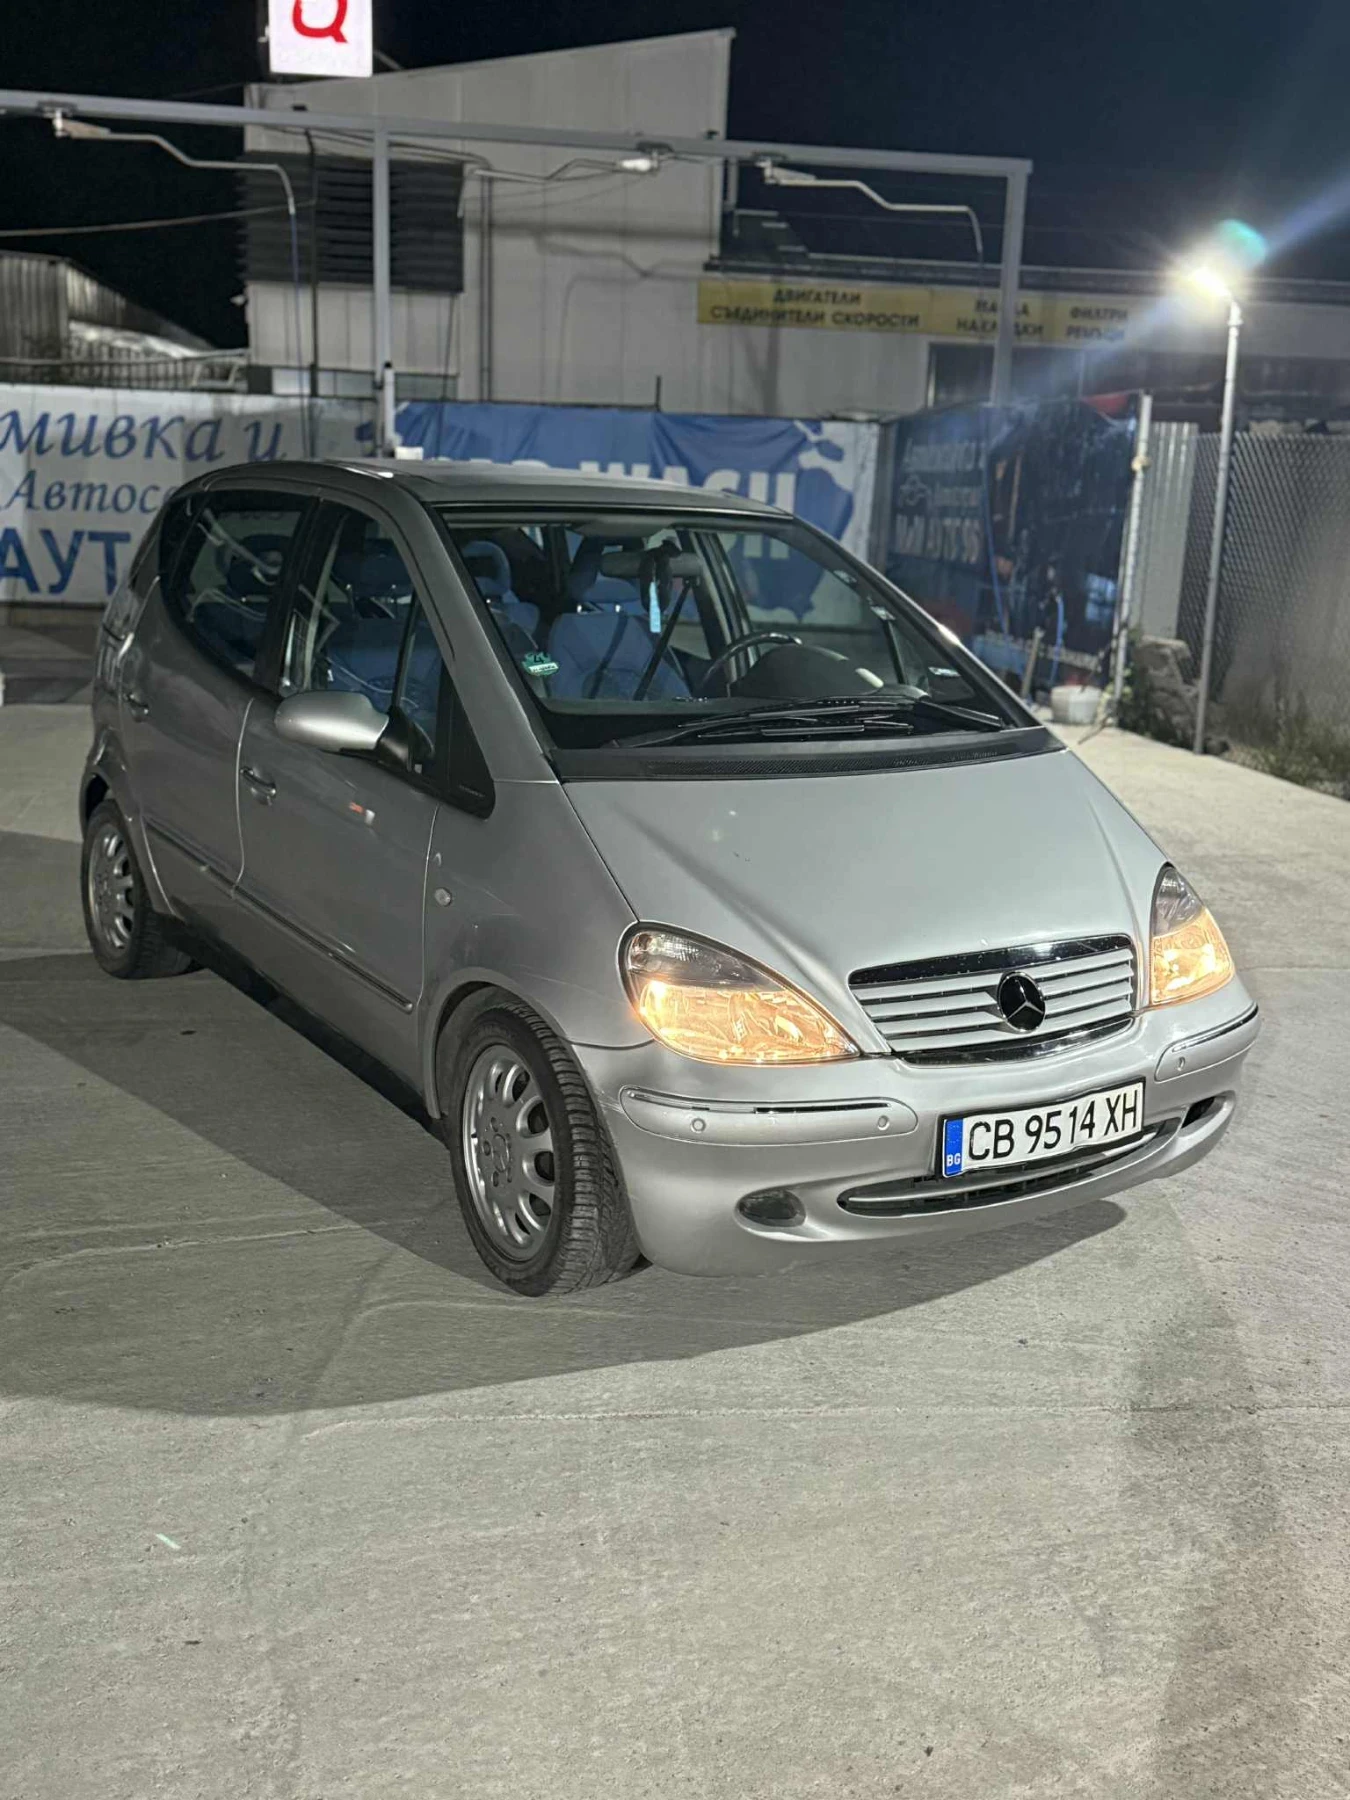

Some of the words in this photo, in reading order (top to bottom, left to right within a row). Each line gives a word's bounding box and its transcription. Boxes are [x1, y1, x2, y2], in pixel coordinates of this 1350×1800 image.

[773, 288, 862, 305] ДВИГАТЕЛИ
[710, 305, 825, 323] СЪЕДИНИТЕЛИ
[831, 311, 920, 327] СКОРОСТИ
[1024, 1100, 1096, 1154] 9514
[946, 1153, 961, 1167] BG
